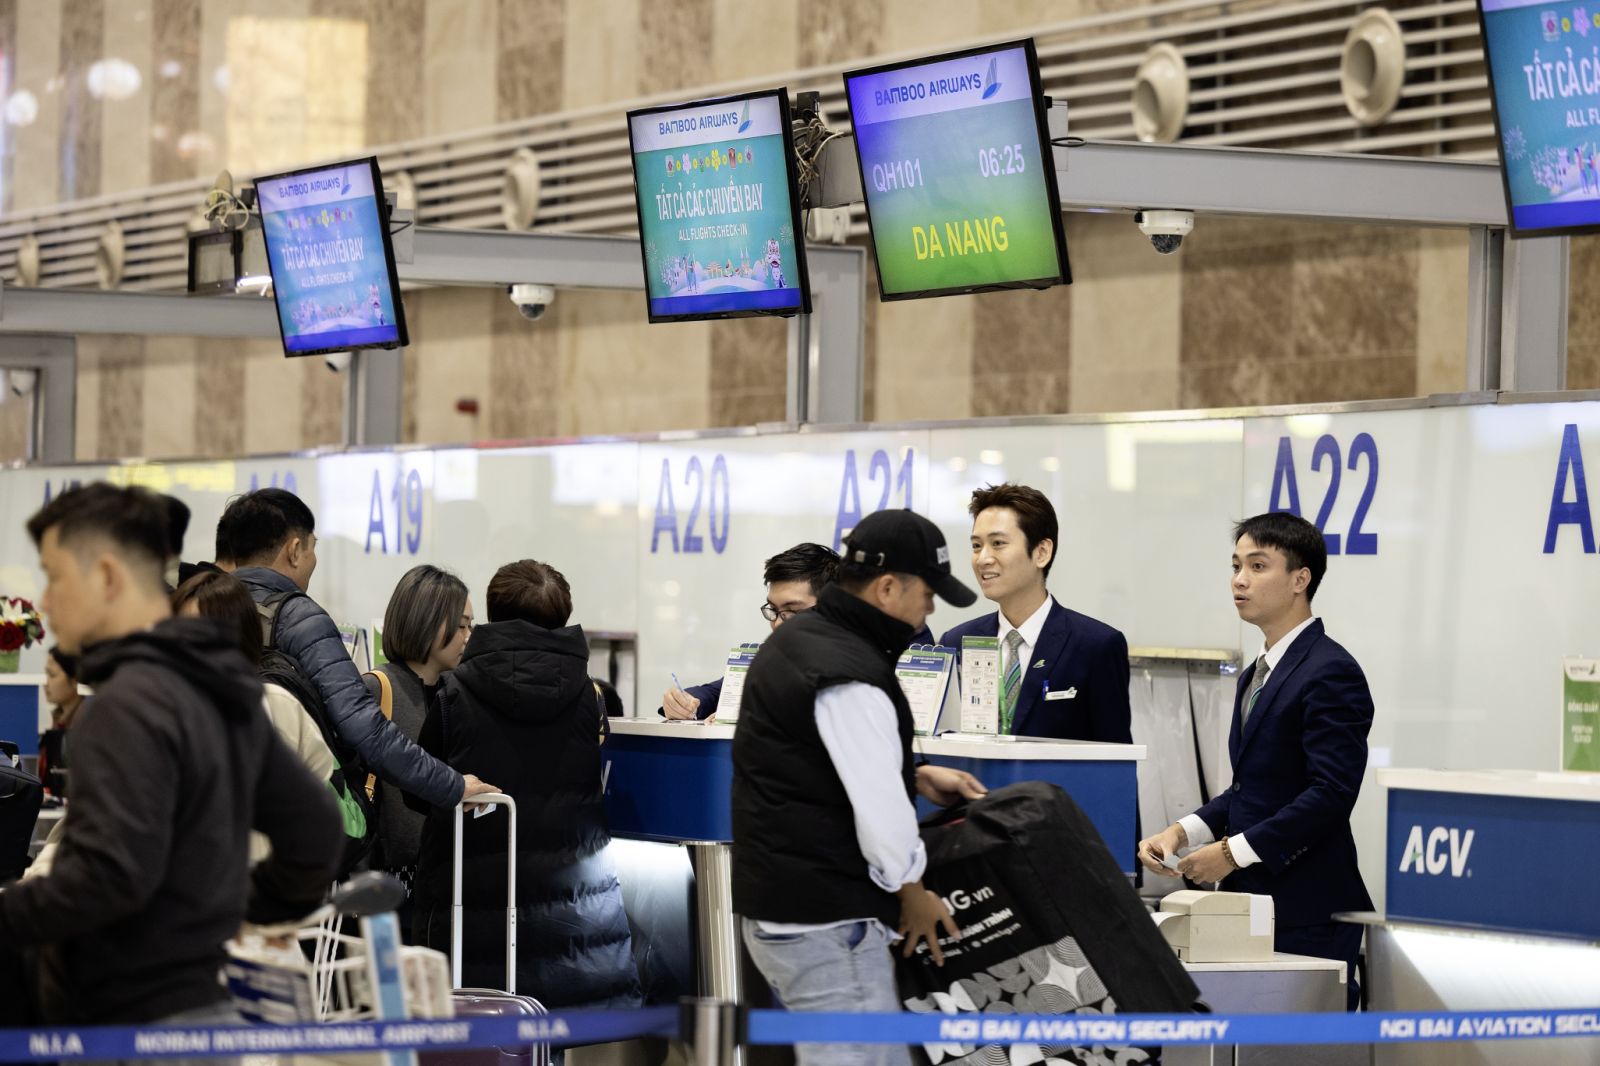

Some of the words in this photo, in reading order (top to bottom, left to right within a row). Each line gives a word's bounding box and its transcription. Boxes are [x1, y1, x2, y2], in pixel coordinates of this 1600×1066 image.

[875, 82, 926, 107] BAMBOO
[929, 73, 982, 97] AIRWAYS
[1523, 49, 1554, 101] TẤT
[1555, 46, 1582, 98] CẢ
[659, 117, 697, 135] BAMBOO
[699, 111, 739, 130] AIRWAYS
[1566, 110, 1588, 128] ALL
[279, 182, 309, 199] BAMBOO
[310, 177, 341, 191] AIRWAYS
[872, 158, 924, 193] QH101
[979, 143, 1025, 178] 06:25
[656, 182, 673, 220] TẤT
[705, 174, 744, 216] CHUYẾN
[743, 182, 763, 212] BAY
[678, 228, 691, 241] ALL
[690, 225, 717, 241] FLIGHTS
[716, 223, 748, 238] CHECK-IN
[912, 224, 945, 261] DA
[946, 216, 1009, 257] NANG
[651, 453, 730, 554] A20
[832, 447, 914, 552] A21
[1267, 432, 1379, 555] A22
[1542, 423, 1600, 554] A
[364, 468, 423, 556] A19
[1399, 825, 1475, 878] ACV
[212, 1025, 376, 1052] INTERNATIONAL
[382, 1021, 471, 1045] AIRPORT
[940, 1020, 979, 1040] NOI
[982, 1020, 1021, 1040] BAI
[1023, 1020, 1126, 1040] AVIATION
[1128, 1020, 1230, 1040] SECURITY
[1380, 1019, 1415, 1038] NOI
[1418, 1018, 1453, 1038] BAI
[1457, 1016, 1550, 1037] AVIATION
